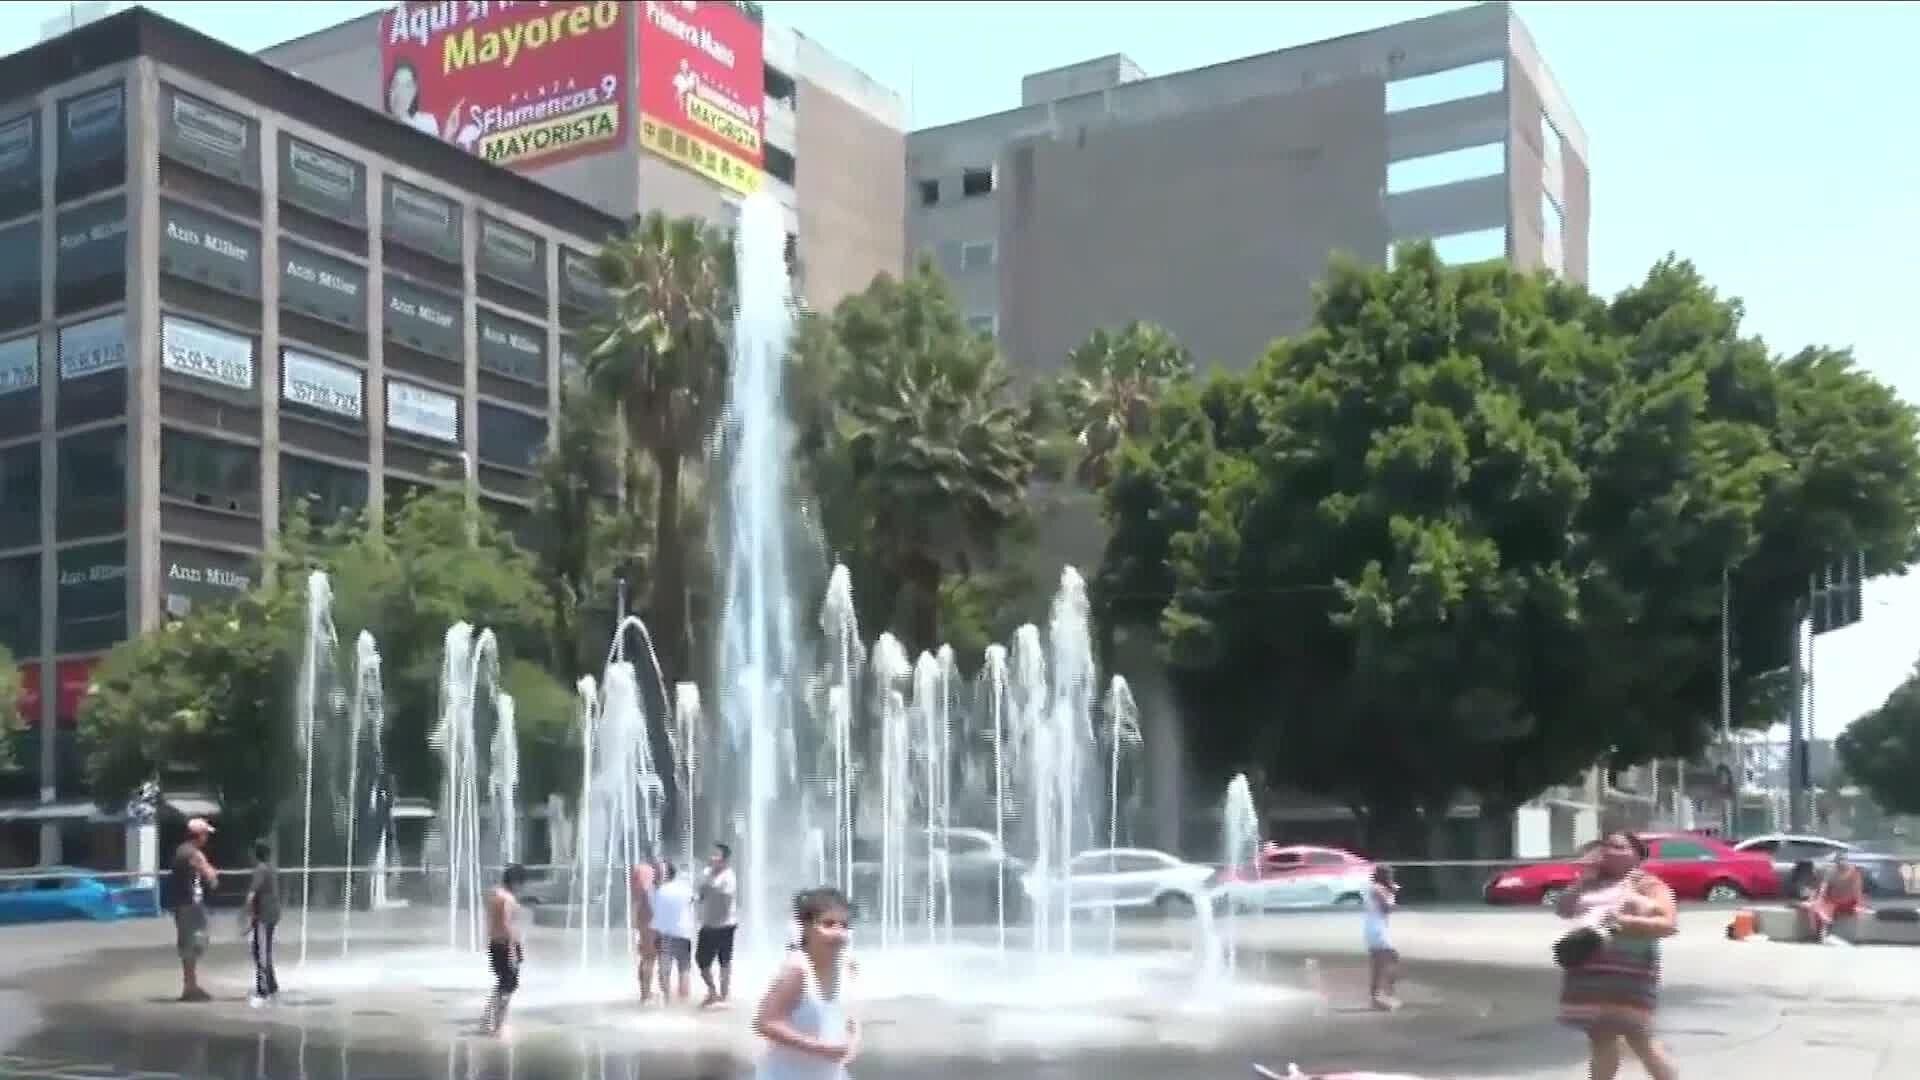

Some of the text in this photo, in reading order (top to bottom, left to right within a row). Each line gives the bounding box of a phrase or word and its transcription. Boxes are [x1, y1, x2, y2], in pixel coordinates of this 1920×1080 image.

[443, 3, 619, 75] Mayoreo
[483, 74, 618, 132] Flamencos 9
[690, 100, 757, 148] MAYORISTA
[485, 112, 613, 160] MAYORISTA
[168, 563, 250, 591] Ann Miller
